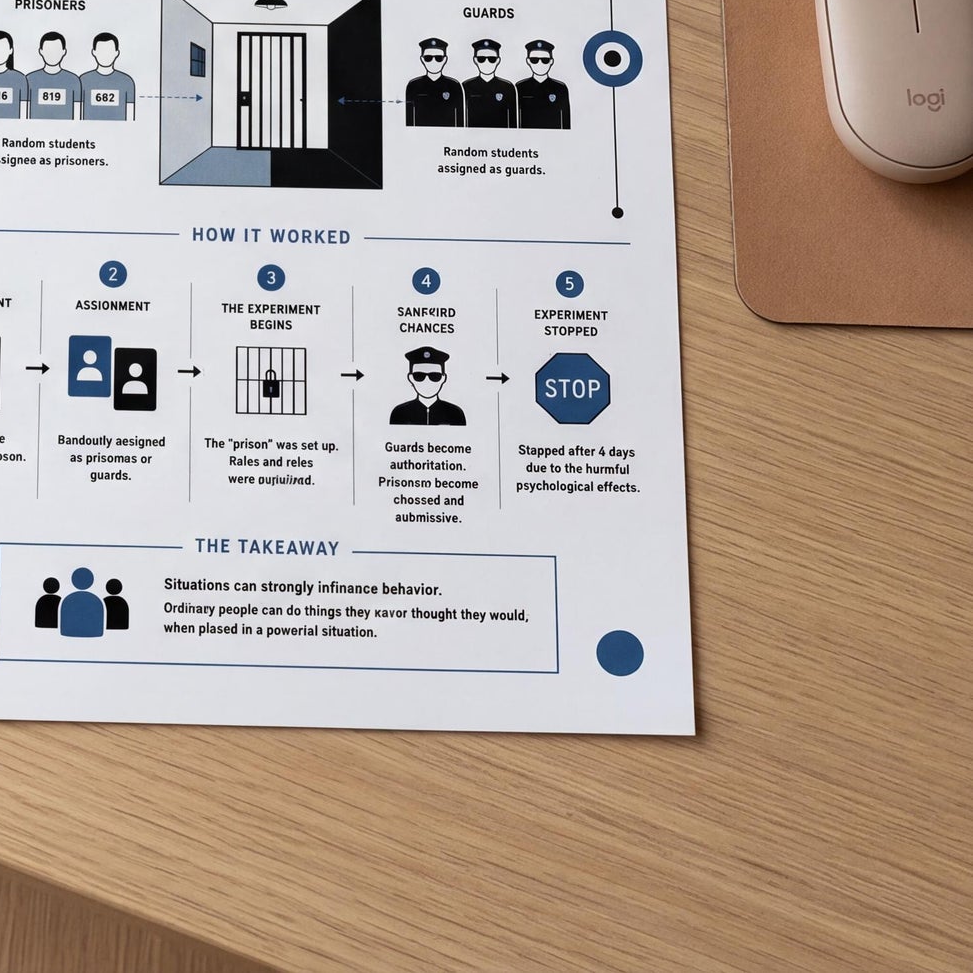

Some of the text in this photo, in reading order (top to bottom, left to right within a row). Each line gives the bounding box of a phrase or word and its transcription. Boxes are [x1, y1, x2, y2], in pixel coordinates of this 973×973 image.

[15, 0, 86, 10] PRISONERS
[463, 7, 514, 19] GUARDS
[43, 92, 61, 101] 819
[96, 93, 115, 102] 682
[906, 89, 945, 112] logi
[2, 137, 96, 149] Random students
[444, 147, 539, 158] Random students
[39, 157, 51, 165] as
[55, 156, 108, 167] prisoners.
[438, 163, 546, 177] assigned as guards.
[193, 228, 350, 244] HOW IT WORKED
[109, 267, 118, 281] 2
[267, 271, 276, 284] 3
[421, 274, 431, 287] 4
[566, 277, 574, 290] 5
[76, 300, 151, 311] ASSIONMENT
[222, 303, 321, 314] THE EXPERIMENT
[535, 310, 608, 320] EXPERIMENT
[250, 320, 292, 330] BEGINS
[400, 323, 455, 333] CHANCES
[545, 326, 598, 336] STOPPED
[545, 379, 600, 398] STOP
[204, 438, 339, 453] The "prison" was set up.
[385, 442, 472, 453] Guards become
[519, 445, 635, 460] Stapped after 4 days
[230, 456, 313, 467] Rales and reles
[390, 459, 466, 471] authoritation.
[526, 462, 629, 474] due to the hurmful
[90, 470, 131, 482] guards.
[228, 476, 255, 484] were
[435, 478, 479, 489] become
[517, 480, 640, 493] psychological effects.
[444, 495, 464, 506] and
[195, 538, 339, 556] THE TAKEAWAY
[164, 578, 230, 591] Situations
[234, 583, 257, 591] can
[261, 581, 314, 596] strongly
[383, 582, 442, 595] behavior.
[219, 604, 258, 617] people
[262, 607, 283, 615] can
[286, 605, 301, 616] do
[304, 605, 342, 620] things
[345, 606, 371, 620] they
[411, 607, 457, 622] thought
[461, 609, 486, 623] they
[490, 609, 529, 622] would,
[164, 622, 195, 633] when
[199, 622, 238, 636] plased
[242, 624, 252, 635] in
[256, 627, 263, 635] a
[322, 625, 377, 637] situation.
